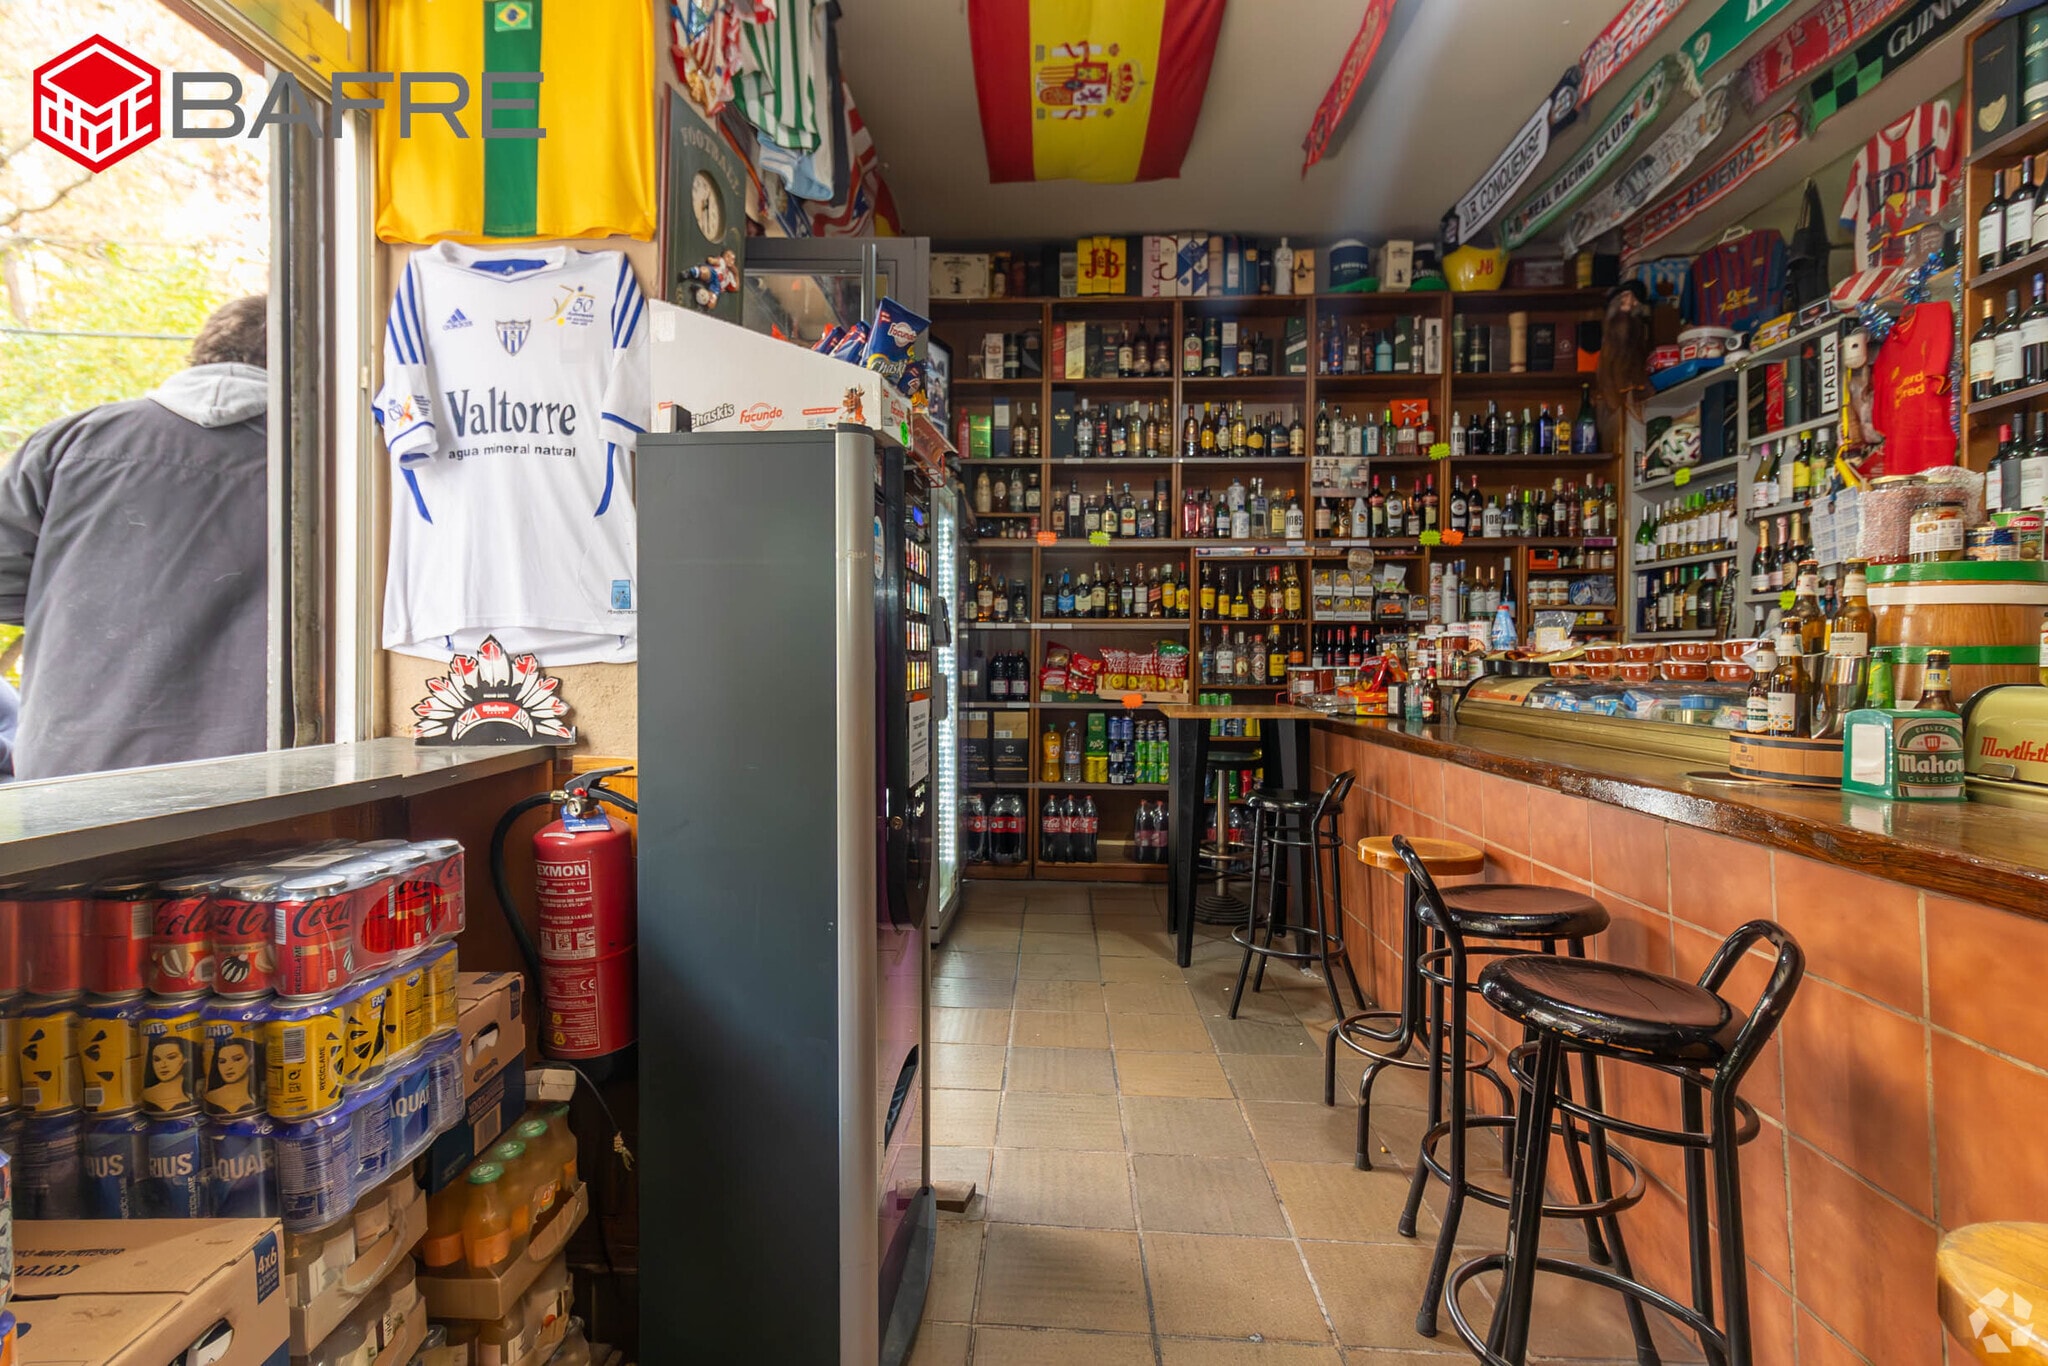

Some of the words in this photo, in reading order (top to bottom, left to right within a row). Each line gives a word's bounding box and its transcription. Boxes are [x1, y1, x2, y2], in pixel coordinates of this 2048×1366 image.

[1596, 112, 1633, 159] CLUB
[1824, 342, 1837, 405] HABLA
[445, 387, 577, 438] Valtorre
[738, 406, 784, 424] Facundo
[448, 448, 480, 461] agua
[484, 442, 531, 456] mineral
[534, 446, 577, 459] natural
[257, 1246, 278, 1275] 4x6
